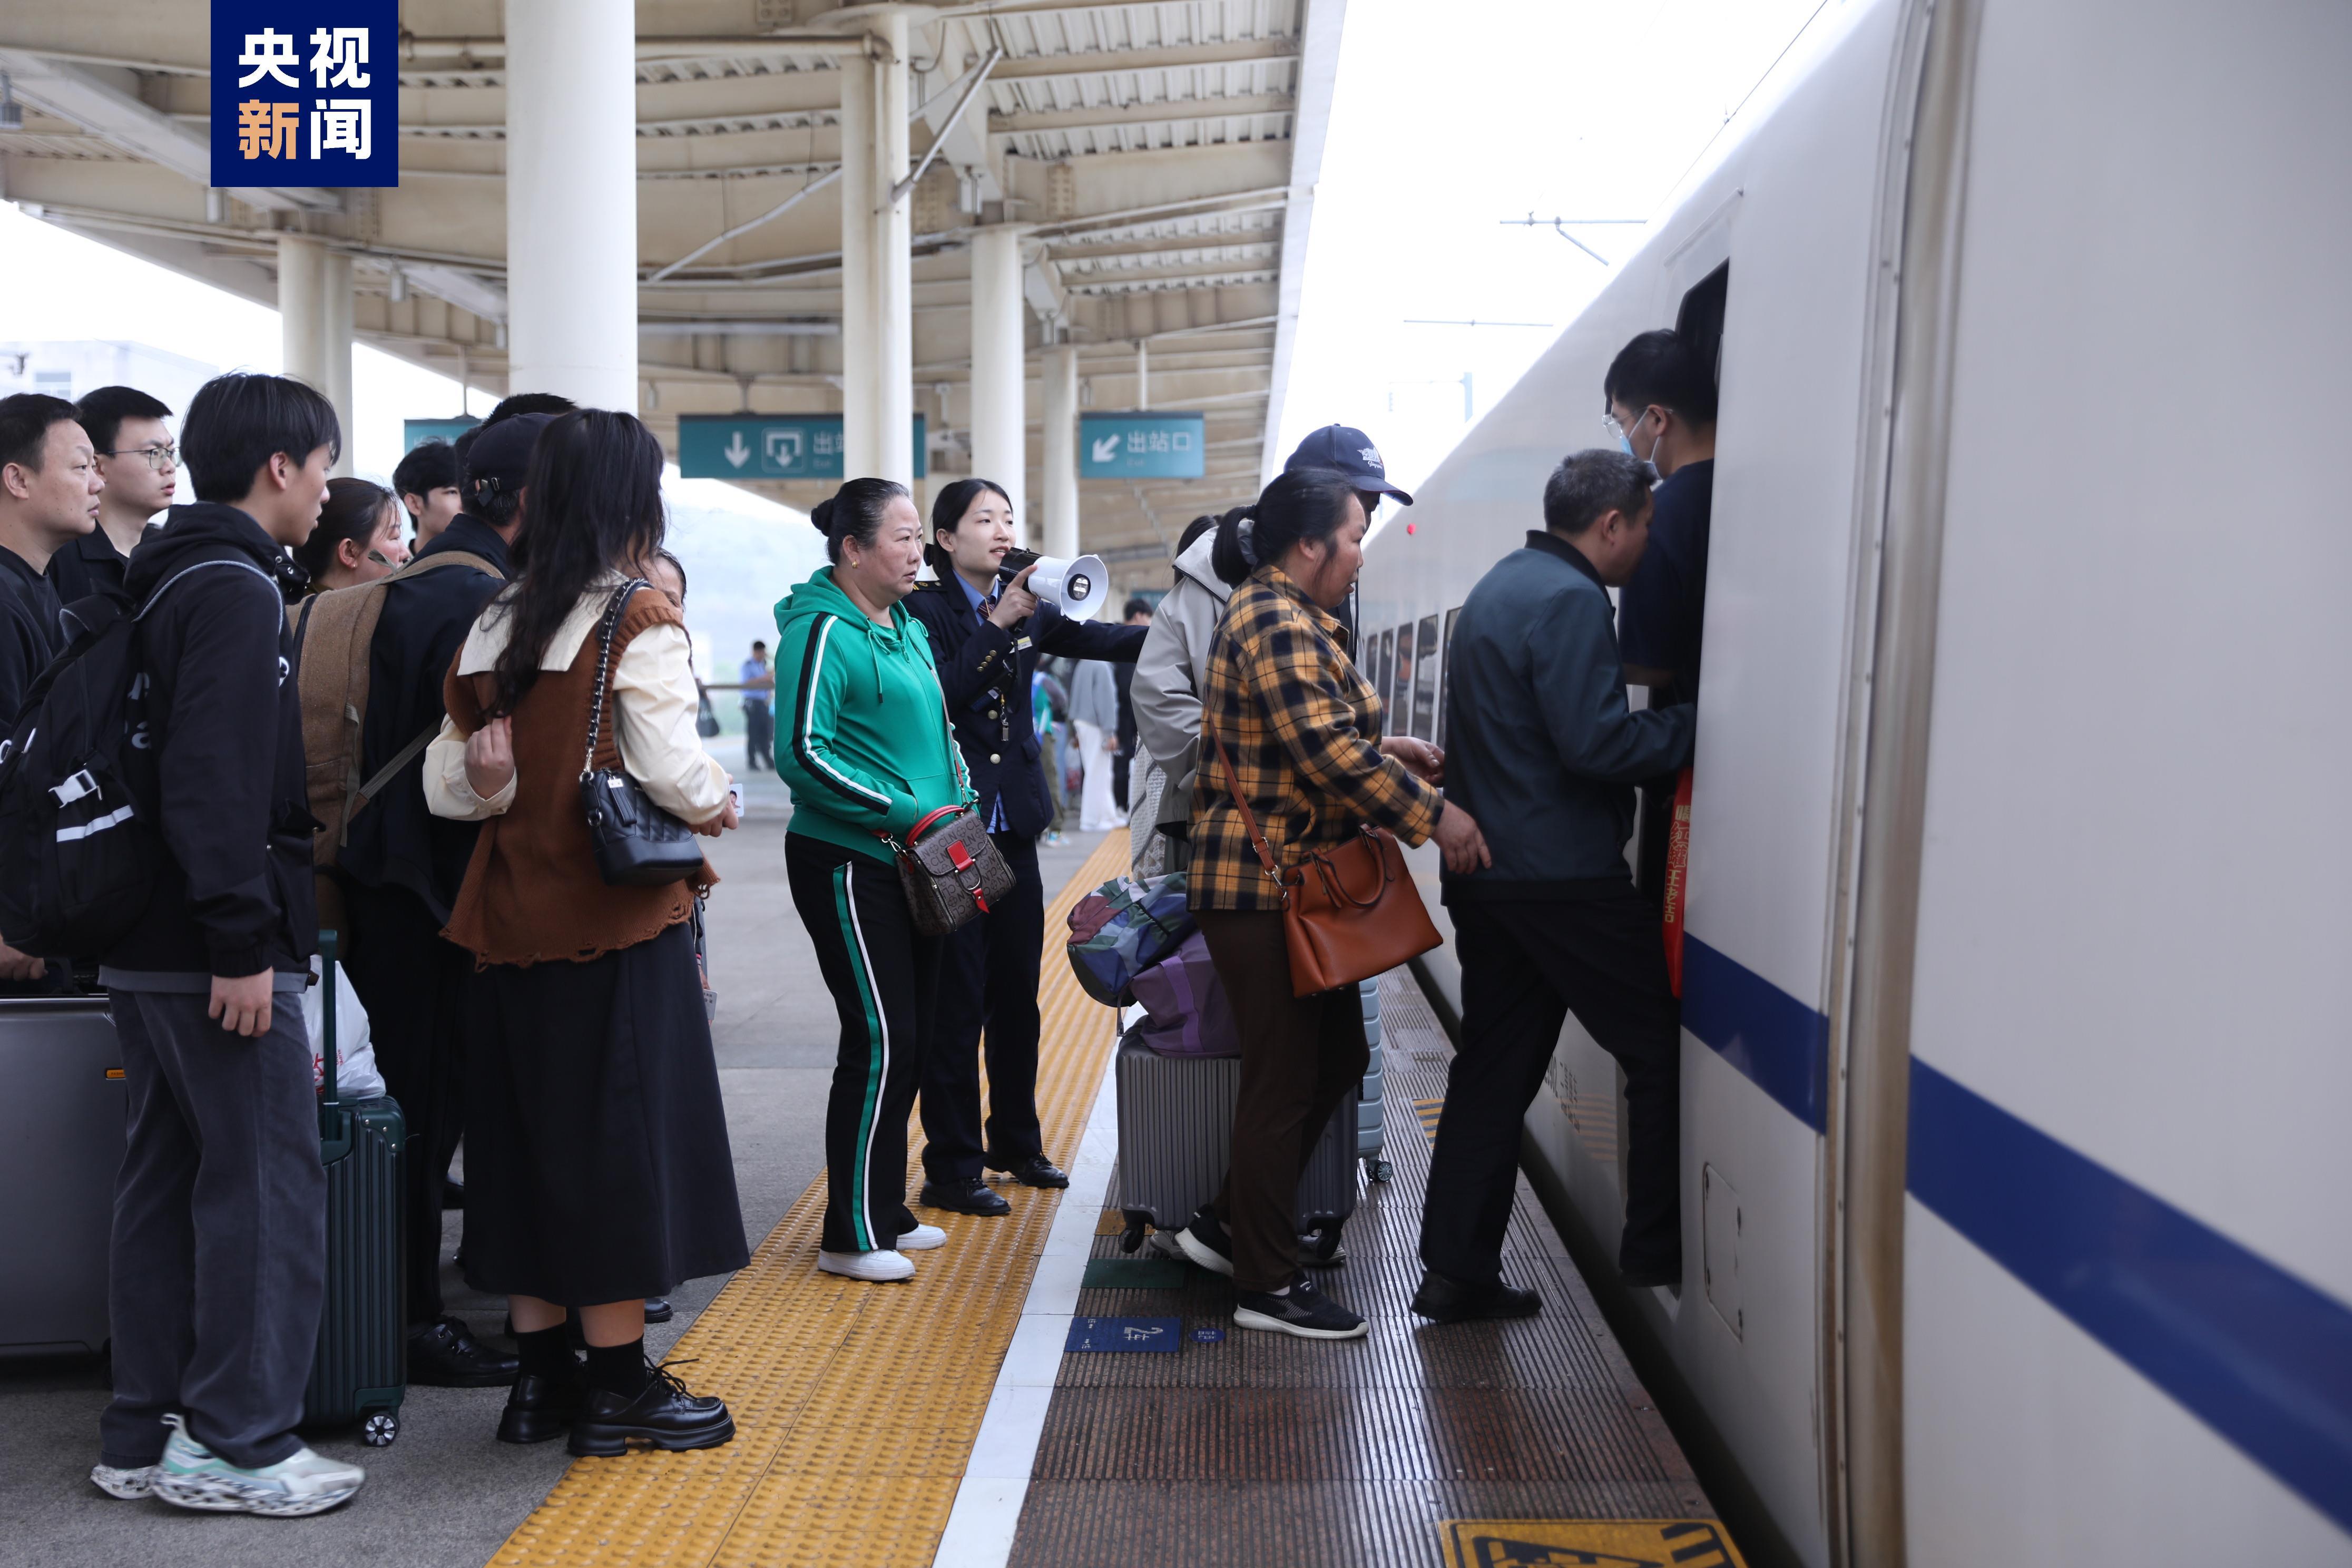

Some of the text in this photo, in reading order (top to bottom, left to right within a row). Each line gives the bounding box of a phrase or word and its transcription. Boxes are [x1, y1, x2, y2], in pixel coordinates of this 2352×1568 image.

[1127, 429, 1191, 453] 出站口
[938, 832, 957, 847] CLN
[930, 851, 948, 867] CLN
